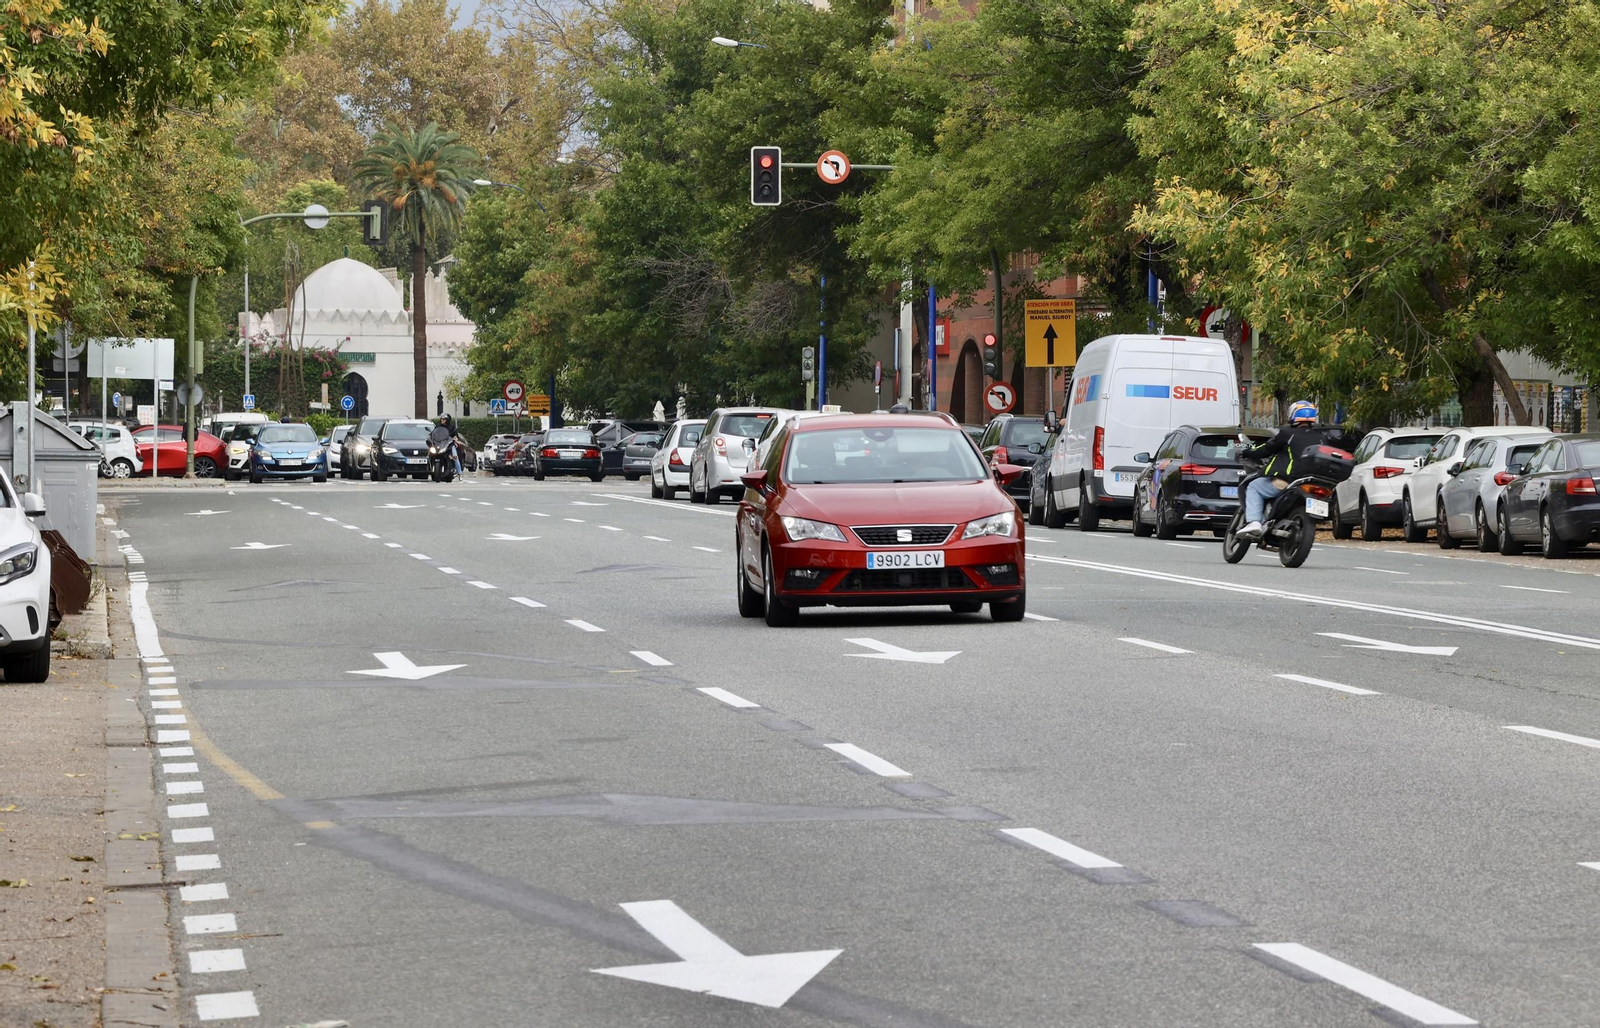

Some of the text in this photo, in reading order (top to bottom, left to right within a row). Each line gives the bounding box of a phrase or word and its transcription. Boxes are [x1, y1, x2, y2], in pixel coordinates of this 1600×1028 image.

[1173, 386, 1217, 401] SEUR
[876, 553, 940, 567] 9902 LCV
